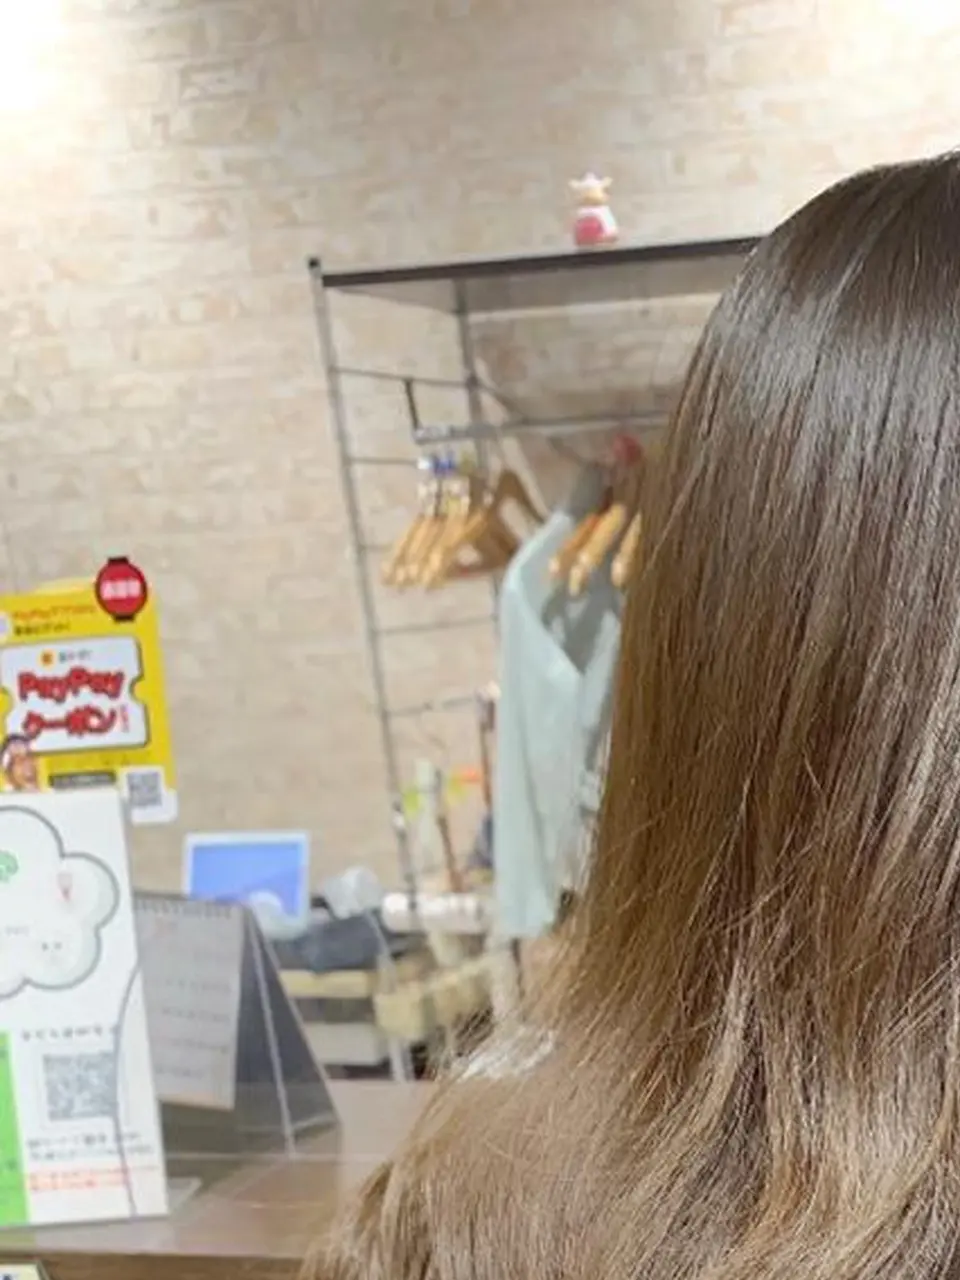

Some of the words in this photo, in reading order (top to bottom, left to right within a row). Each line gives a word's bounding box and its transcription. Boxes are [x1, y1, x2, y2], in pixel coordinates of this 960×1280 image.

[18, 667, 124, 705] PayPay
[22, 704, 117, 740] クーポン
